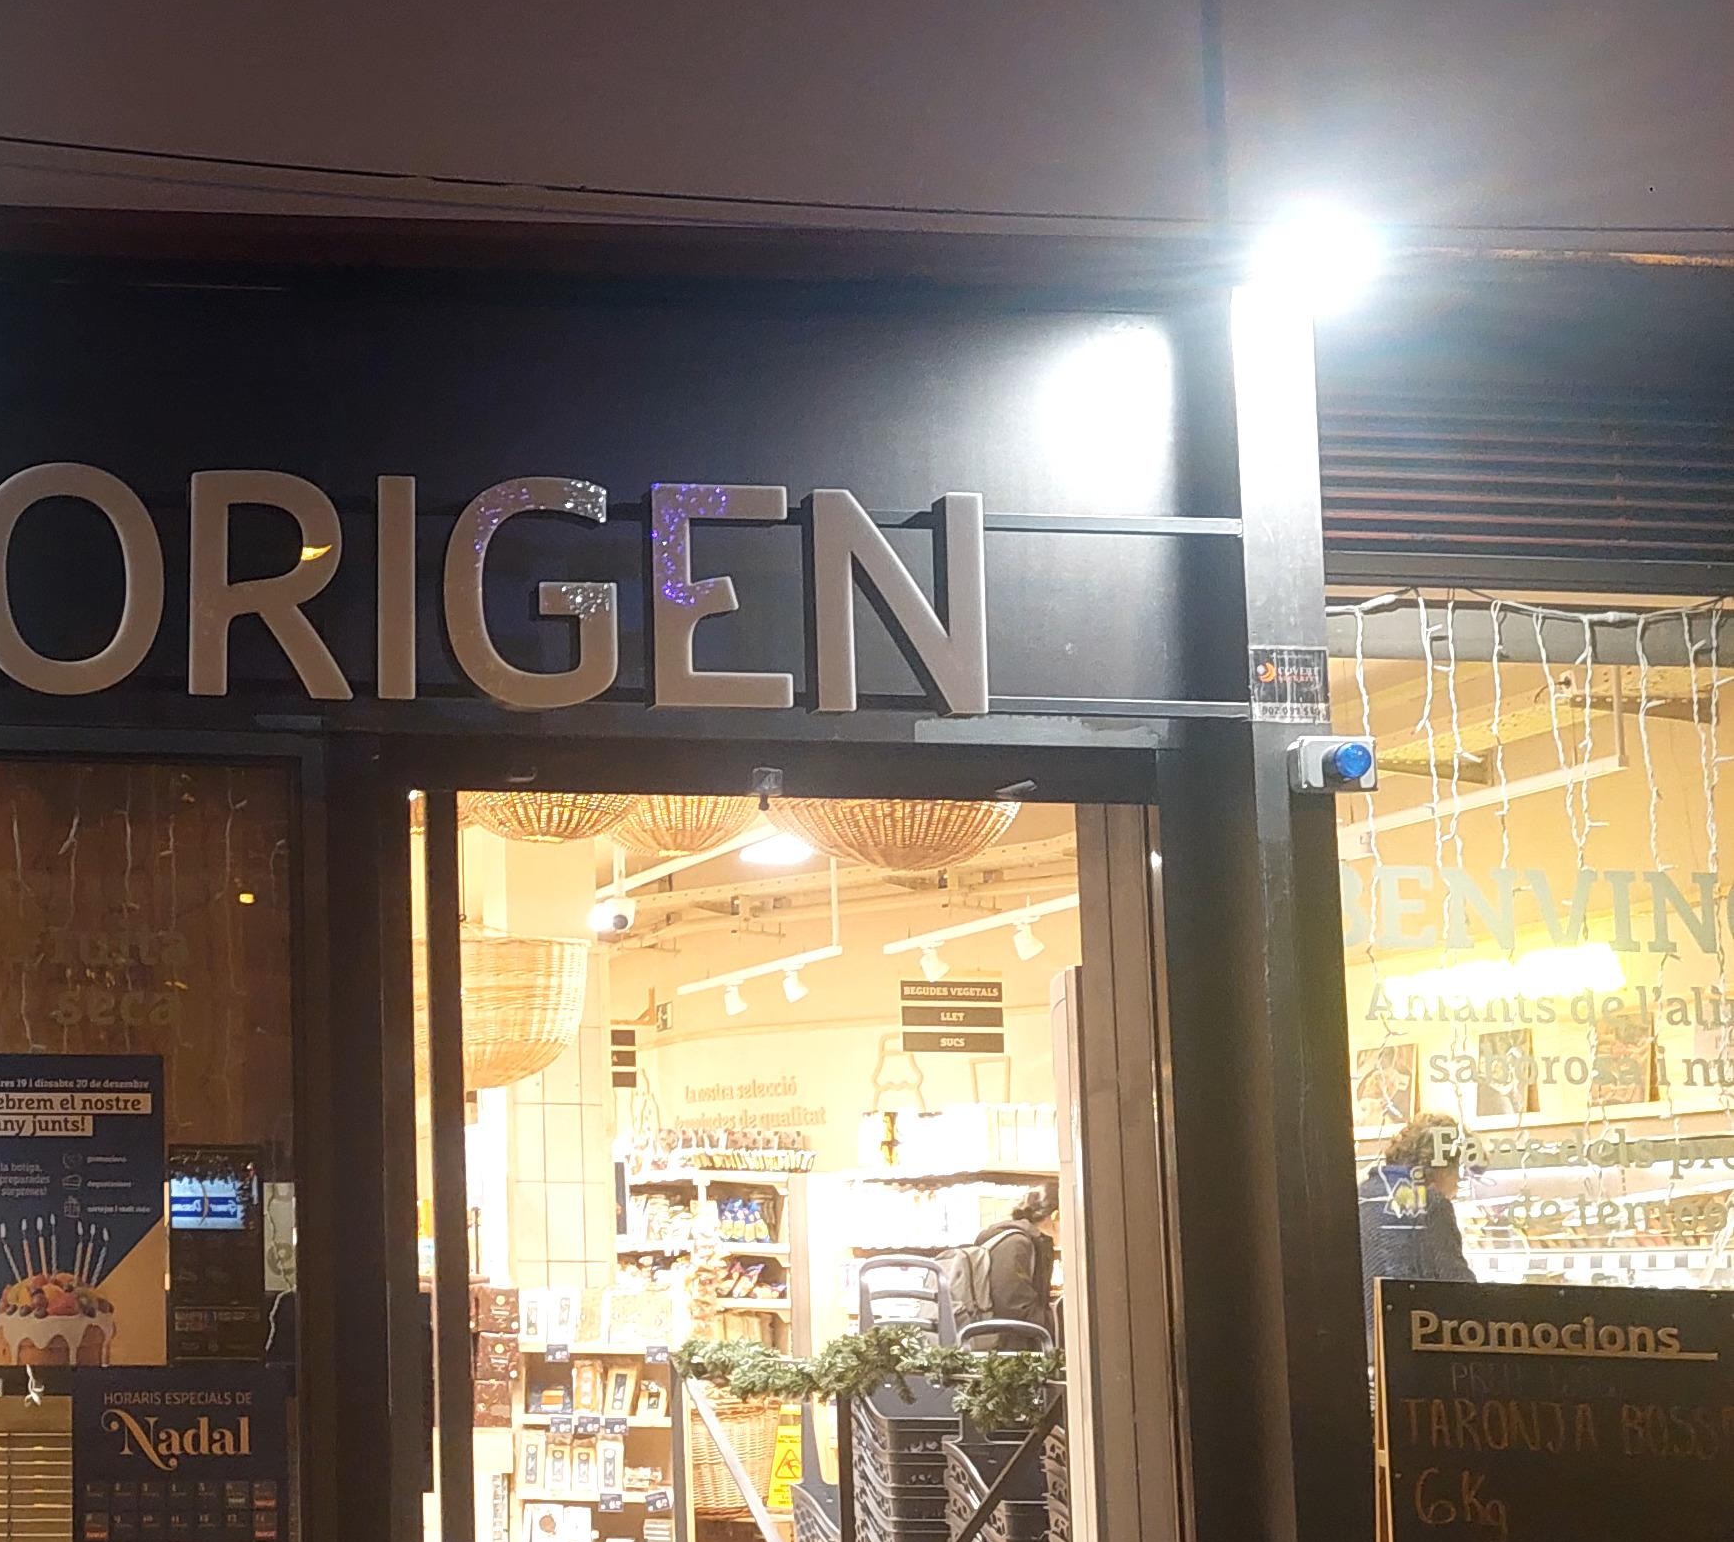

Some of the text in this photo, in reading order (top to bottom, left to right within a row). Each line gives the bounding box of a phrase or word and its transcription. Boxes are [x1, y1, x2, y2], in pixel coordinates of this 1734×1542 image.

[1342, 866, 1734, 955] ENVIN
[903, 986, 999, 997] BEGUDES VEGETALS
[940, 1012, 965, 1022] LLET
[1570, 986, 1626, 1025] de
[1635, 986, 1734, 1028] l'ali
[940, 1038, 965, 1048] SUCS
[1657, 1045, 1671, 1086] i
[60, 1094, 76, 1111] el
[82, 1095, 142, 1111] nostre
[30, 1115, 86, 1137] junts!
[1410, 1310, 1682, 1355] Promocions
[104, 1391, 253, 1406] HORARIS ESPECIALS DE
[101, 1409, 251, 1471] Nadal
